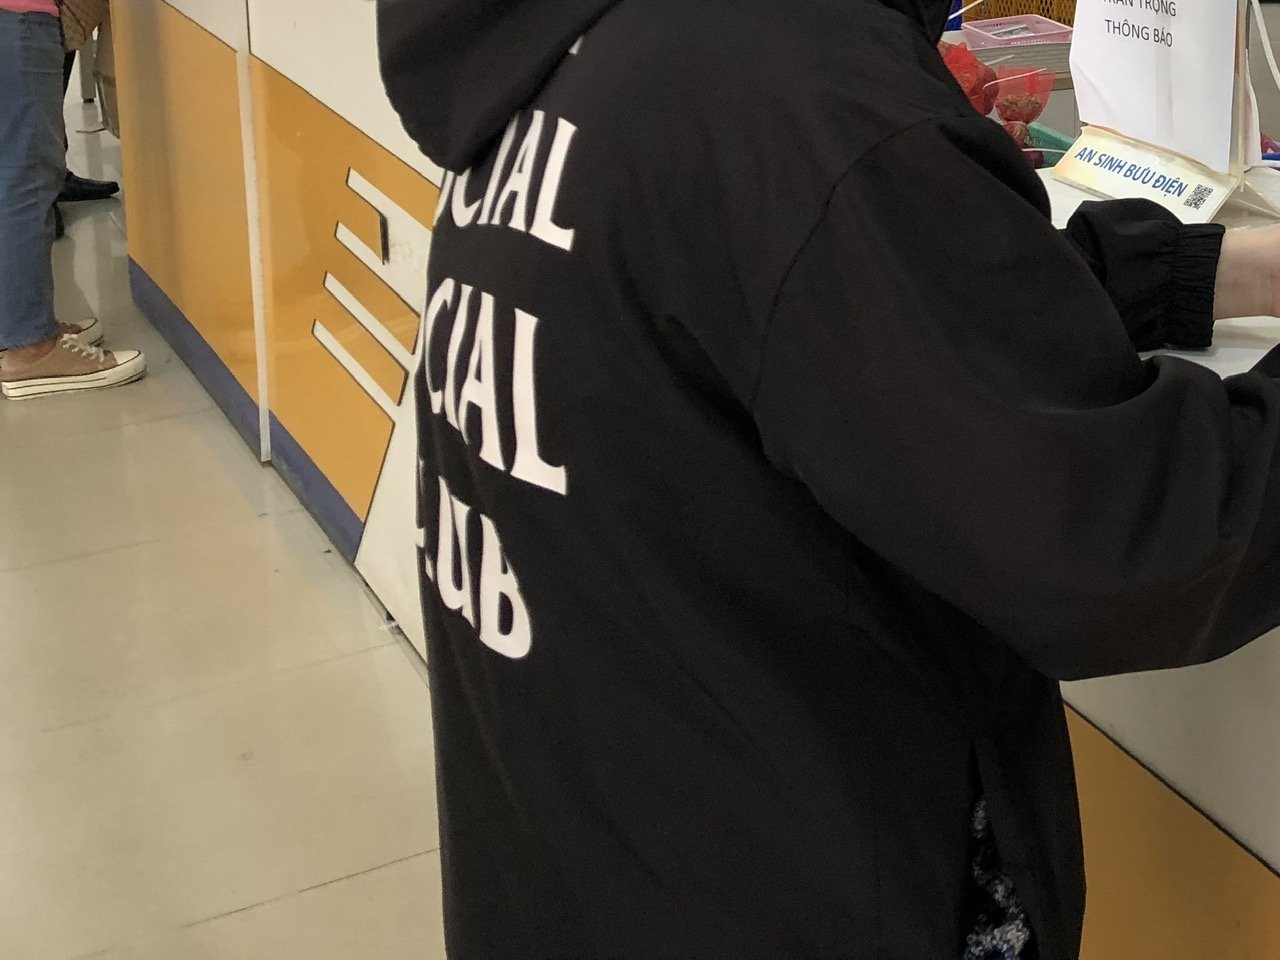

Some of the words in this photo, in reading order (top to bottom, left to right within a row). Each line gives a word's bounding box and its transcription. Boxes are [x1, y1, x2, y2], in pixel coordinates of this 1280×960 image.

[1104, 19, 1150, 41] THÔNG
[1153, 26, 1173, 48] BÁO
[1074, 146, 1098, 163] AN
[1093, 153, 1126, 175] SINH
[1123, 163, 1157, 185] BƯU
[1151, 176, 1189, 198] ĐIỆN
[425, 475, 532, 660] UB
